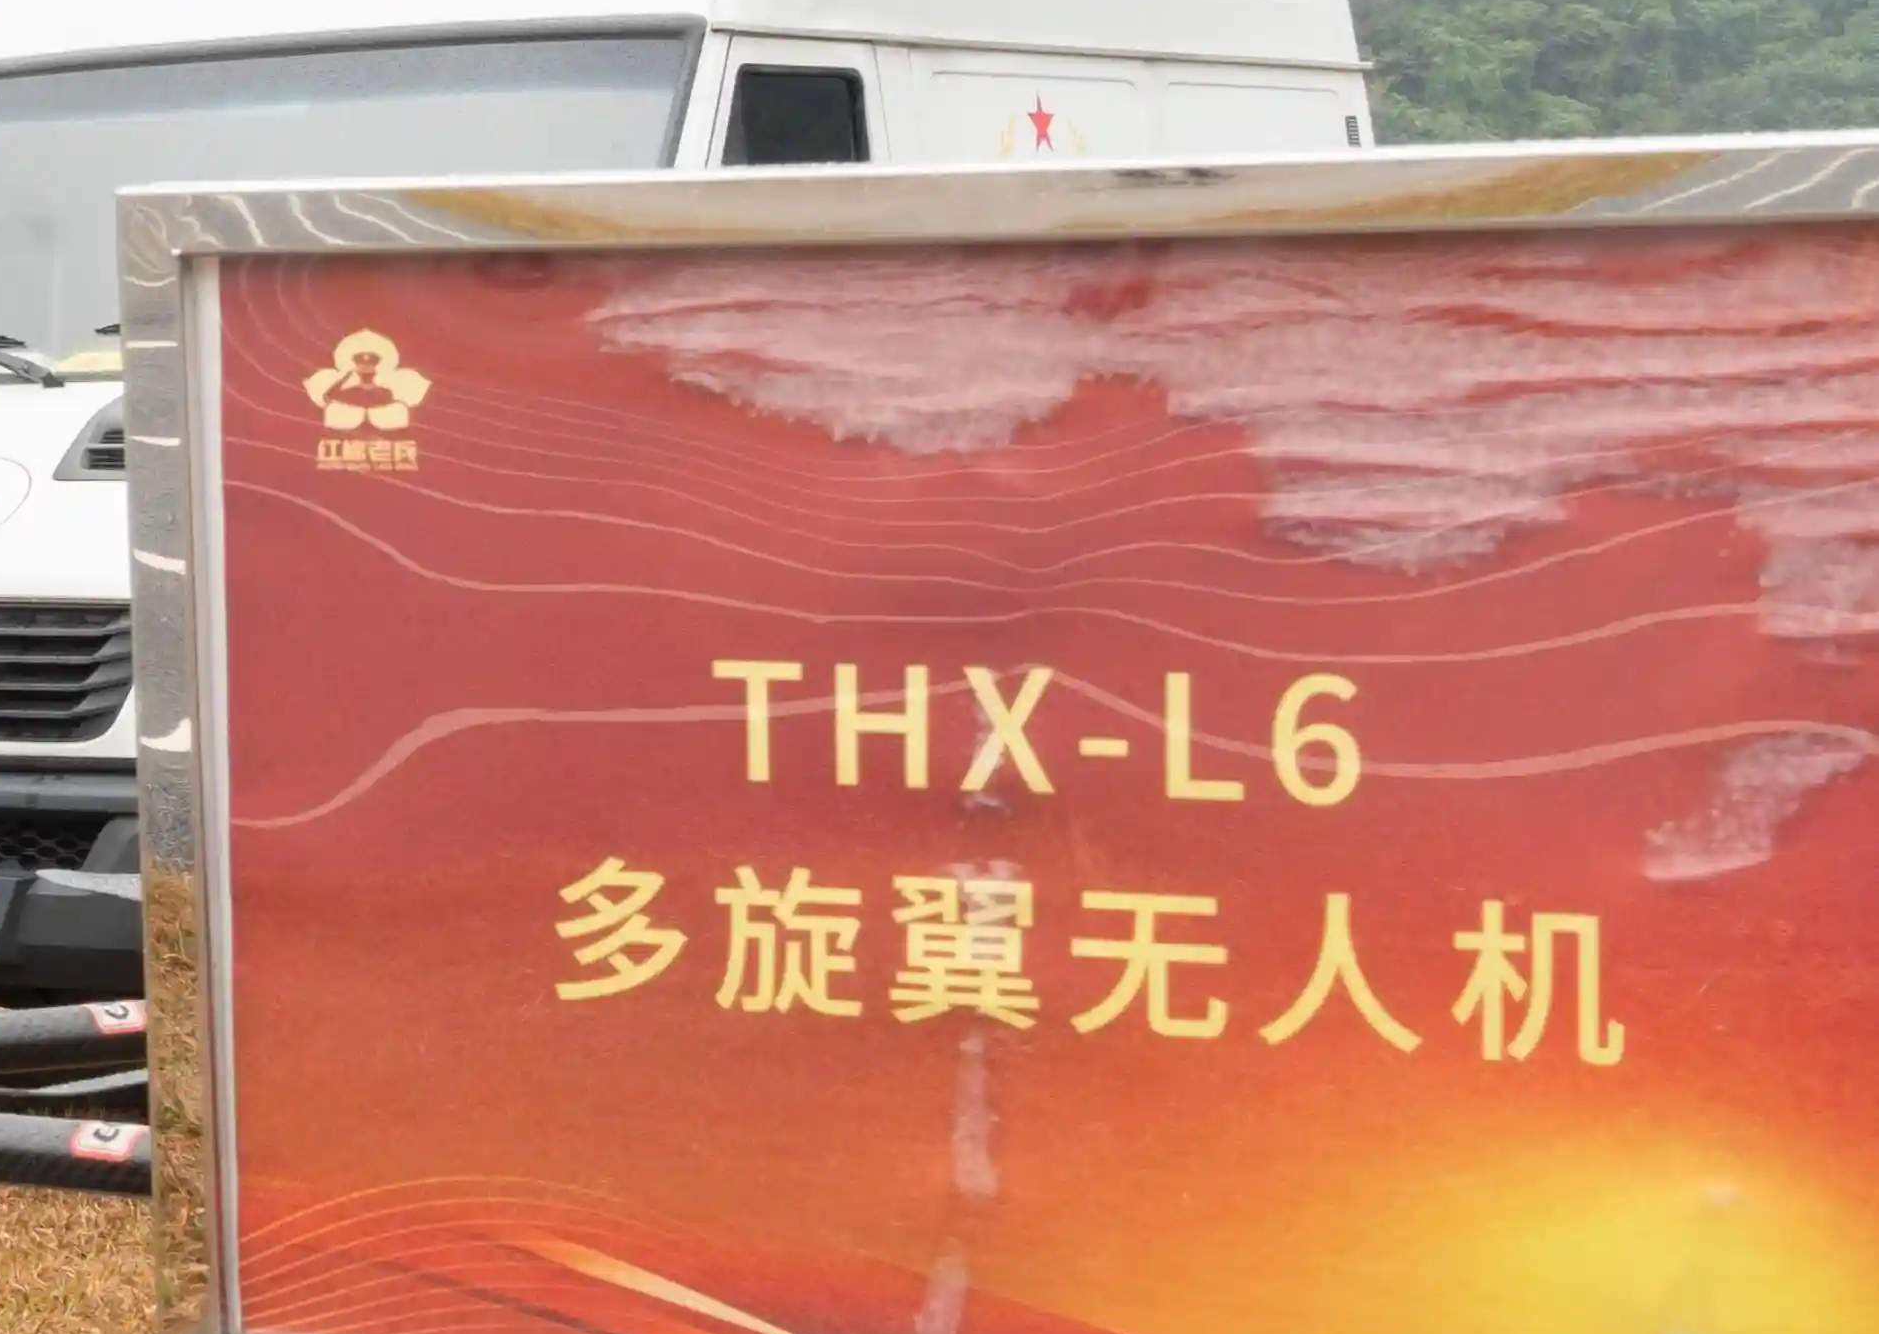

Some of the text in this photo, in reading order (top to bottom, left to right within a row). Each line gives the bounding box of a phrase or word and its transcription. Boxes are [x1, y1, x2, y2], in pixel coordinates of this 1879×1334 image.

[712, 659, 1363, 806] THX-L6
[553, 855, 1626, 1067] 多旋翼无人机
